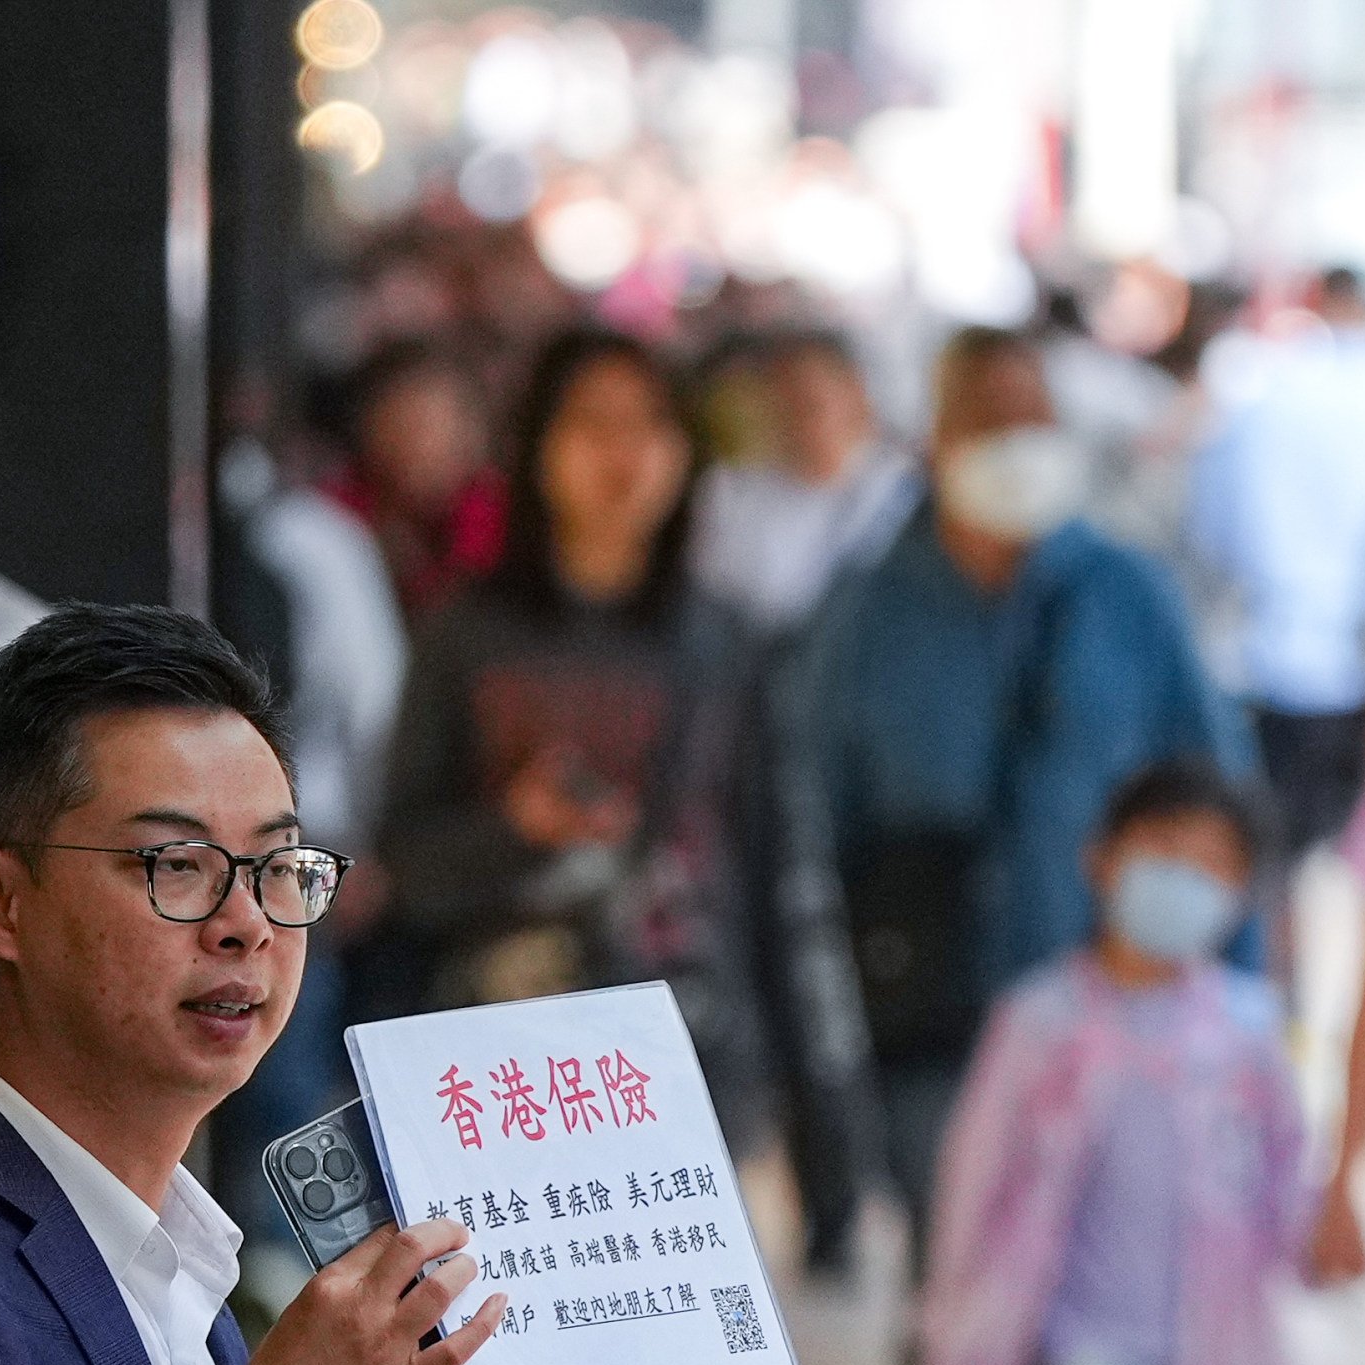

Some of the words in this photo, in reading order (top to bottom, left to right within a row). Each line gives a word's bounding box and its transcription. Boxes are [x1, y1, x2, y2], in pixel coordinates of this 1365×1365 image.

[436, 1048, 657, 1150] 香港保險
[542, 1178, 614, 1220] 重疾險
[625, 1164, 719, 1209] 美元理財
[567, 1232, 643, 1269] 高端醫療
[651, 1222, 727, 1258] 香港移民
[460, 1303, 536, 1340] 開戶
